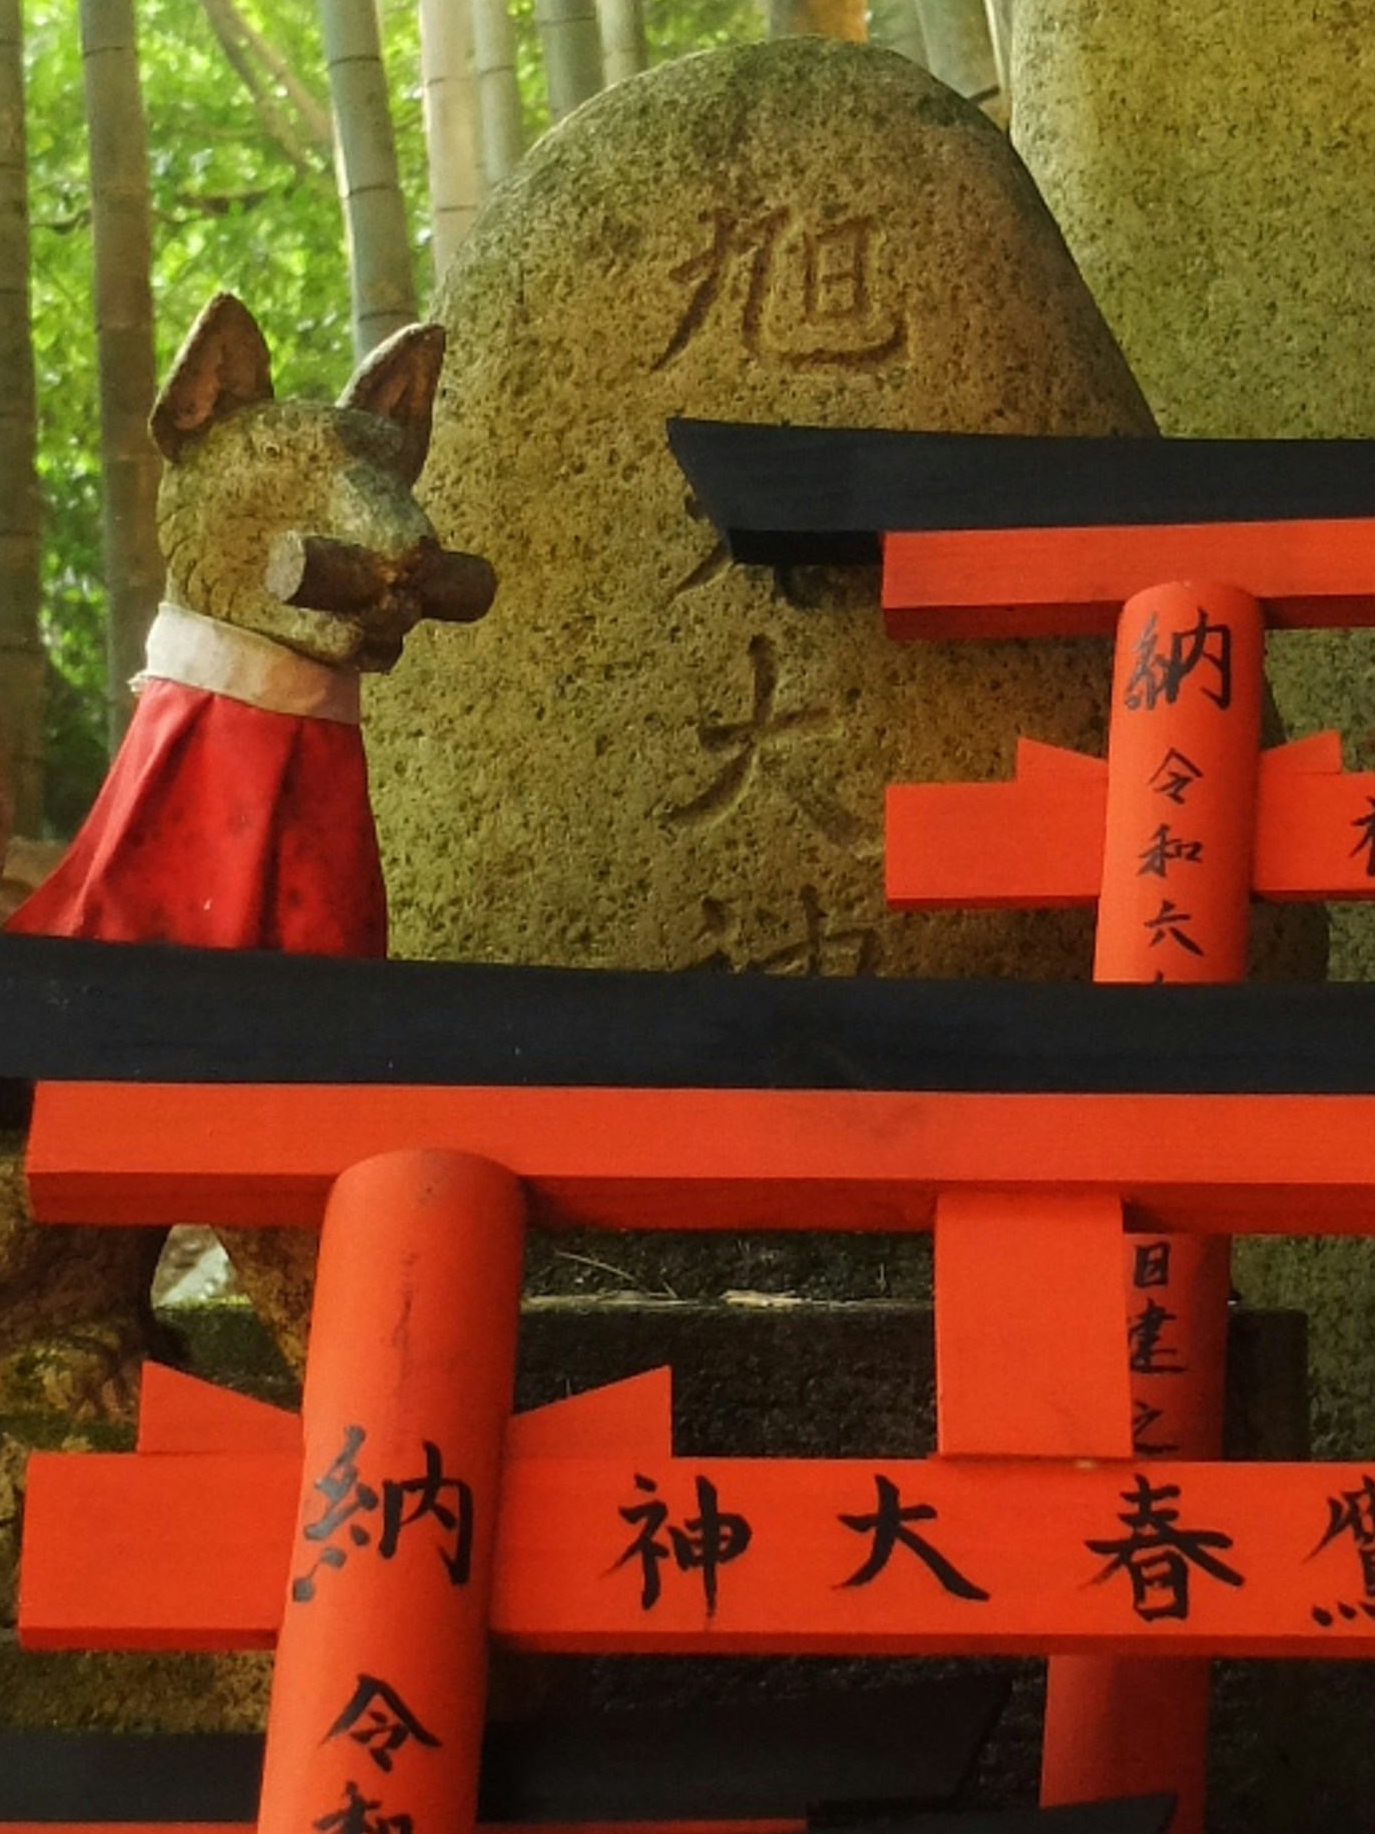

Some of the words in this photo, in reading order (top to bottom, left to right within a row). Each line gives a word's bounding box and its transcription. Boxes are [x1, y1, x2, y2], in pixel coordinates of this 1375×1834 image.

[1125, 607, 1231, 711] 納
[1136, 747, 1205, 982] 令和六
[291, 1423, 474, 1603] 納
